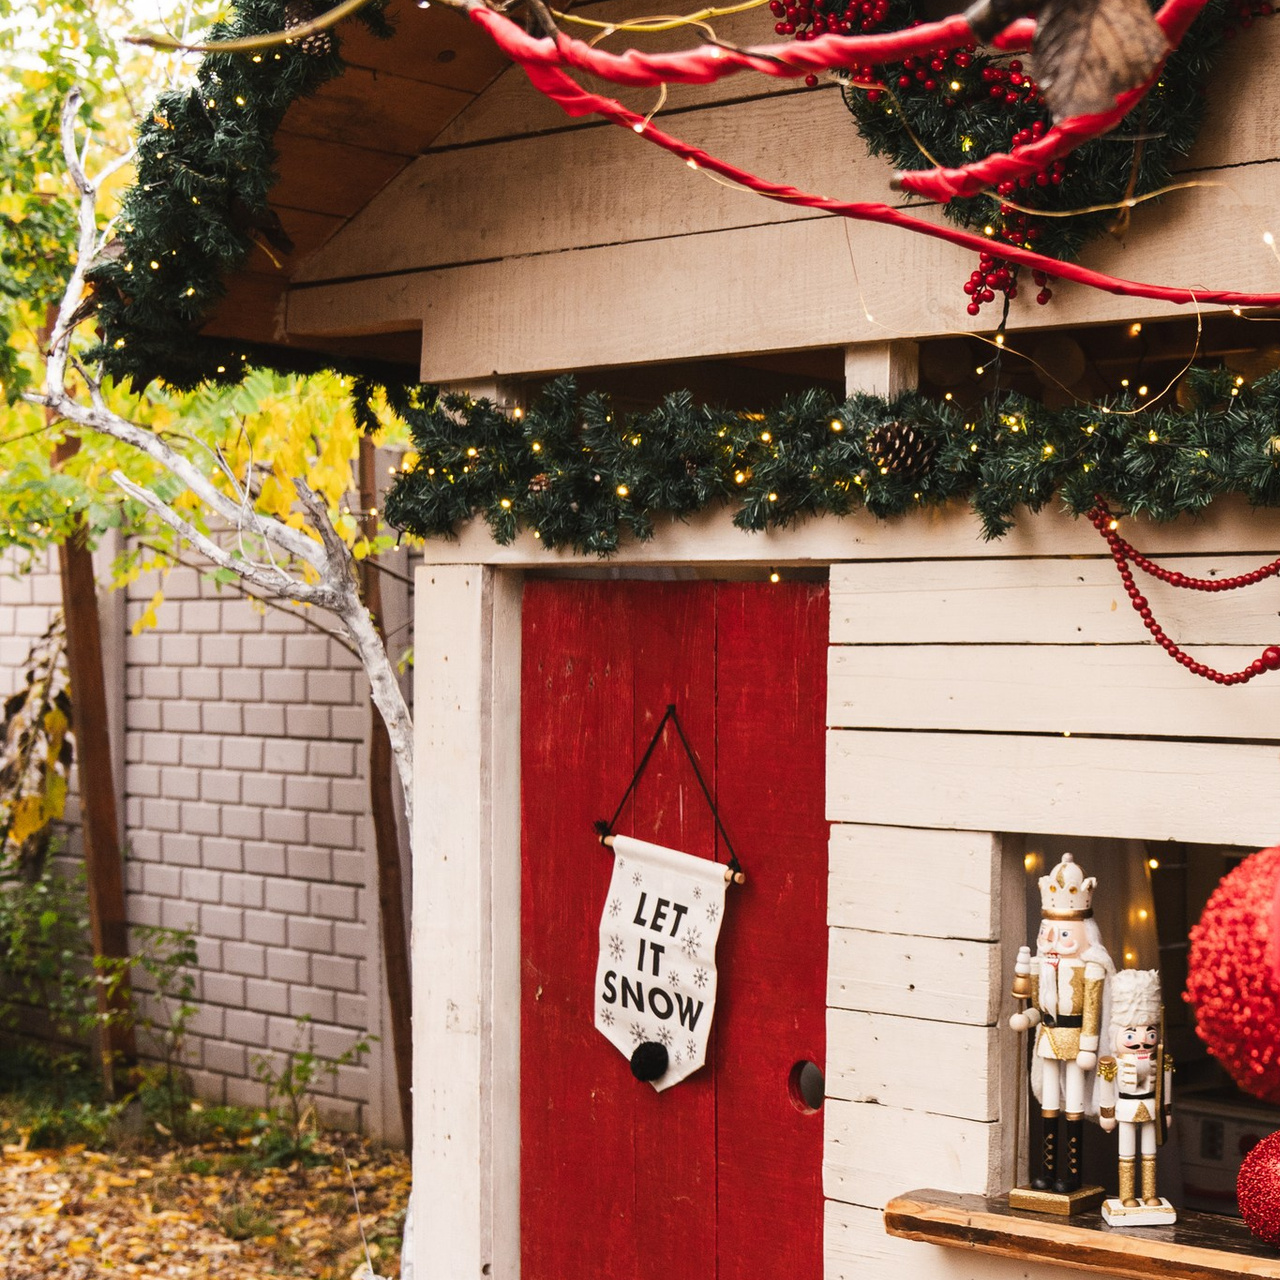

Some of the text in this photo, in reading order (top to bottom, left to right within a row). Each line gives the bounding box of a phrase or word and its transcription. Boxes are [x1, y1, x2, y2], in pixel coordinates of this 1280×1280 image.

[633, 892, 688, 938] LET
[637, 938, 665, 977] IT
[602, 970, 704, 1032] SNOW
